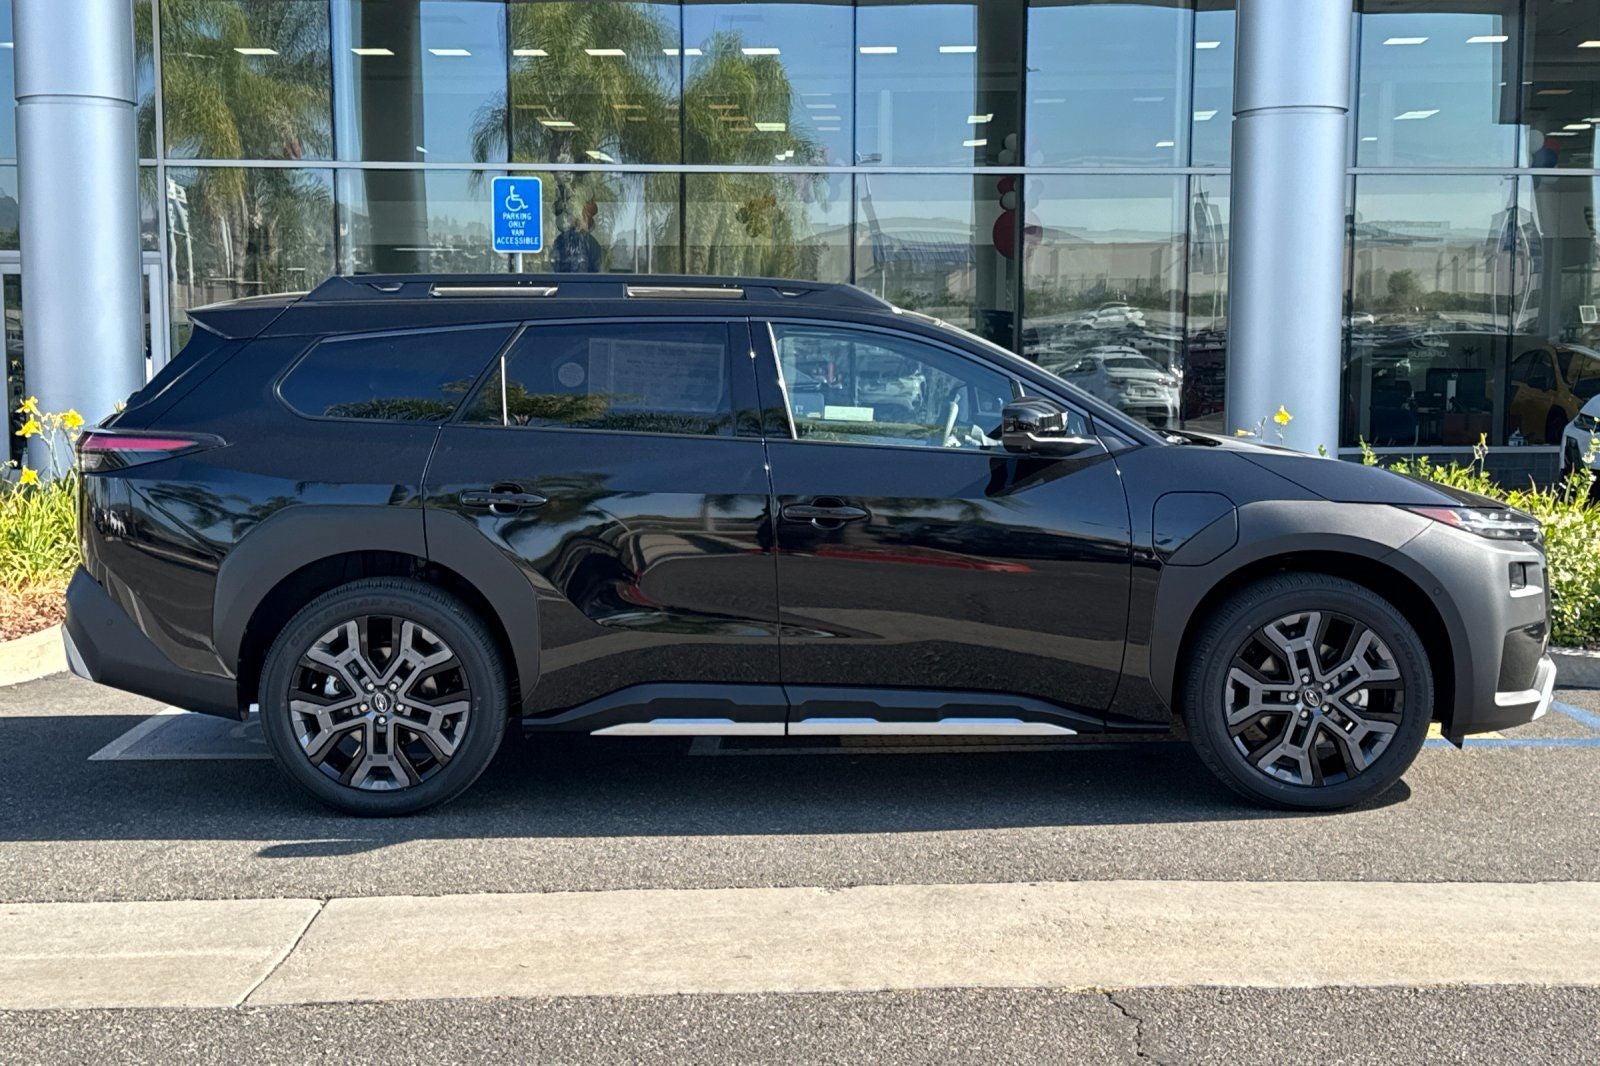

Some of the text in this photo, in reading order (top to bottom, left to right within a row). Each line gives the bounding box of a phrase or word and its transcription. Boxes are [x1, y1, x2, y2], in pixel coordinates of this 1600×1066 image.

[502, 211, 532, 220] PARKING
[508, 220, 526, 229] ONLY
[510, 228, 525, 236] VAN
[496, 236, 539, 245] ACCESSIBLE
